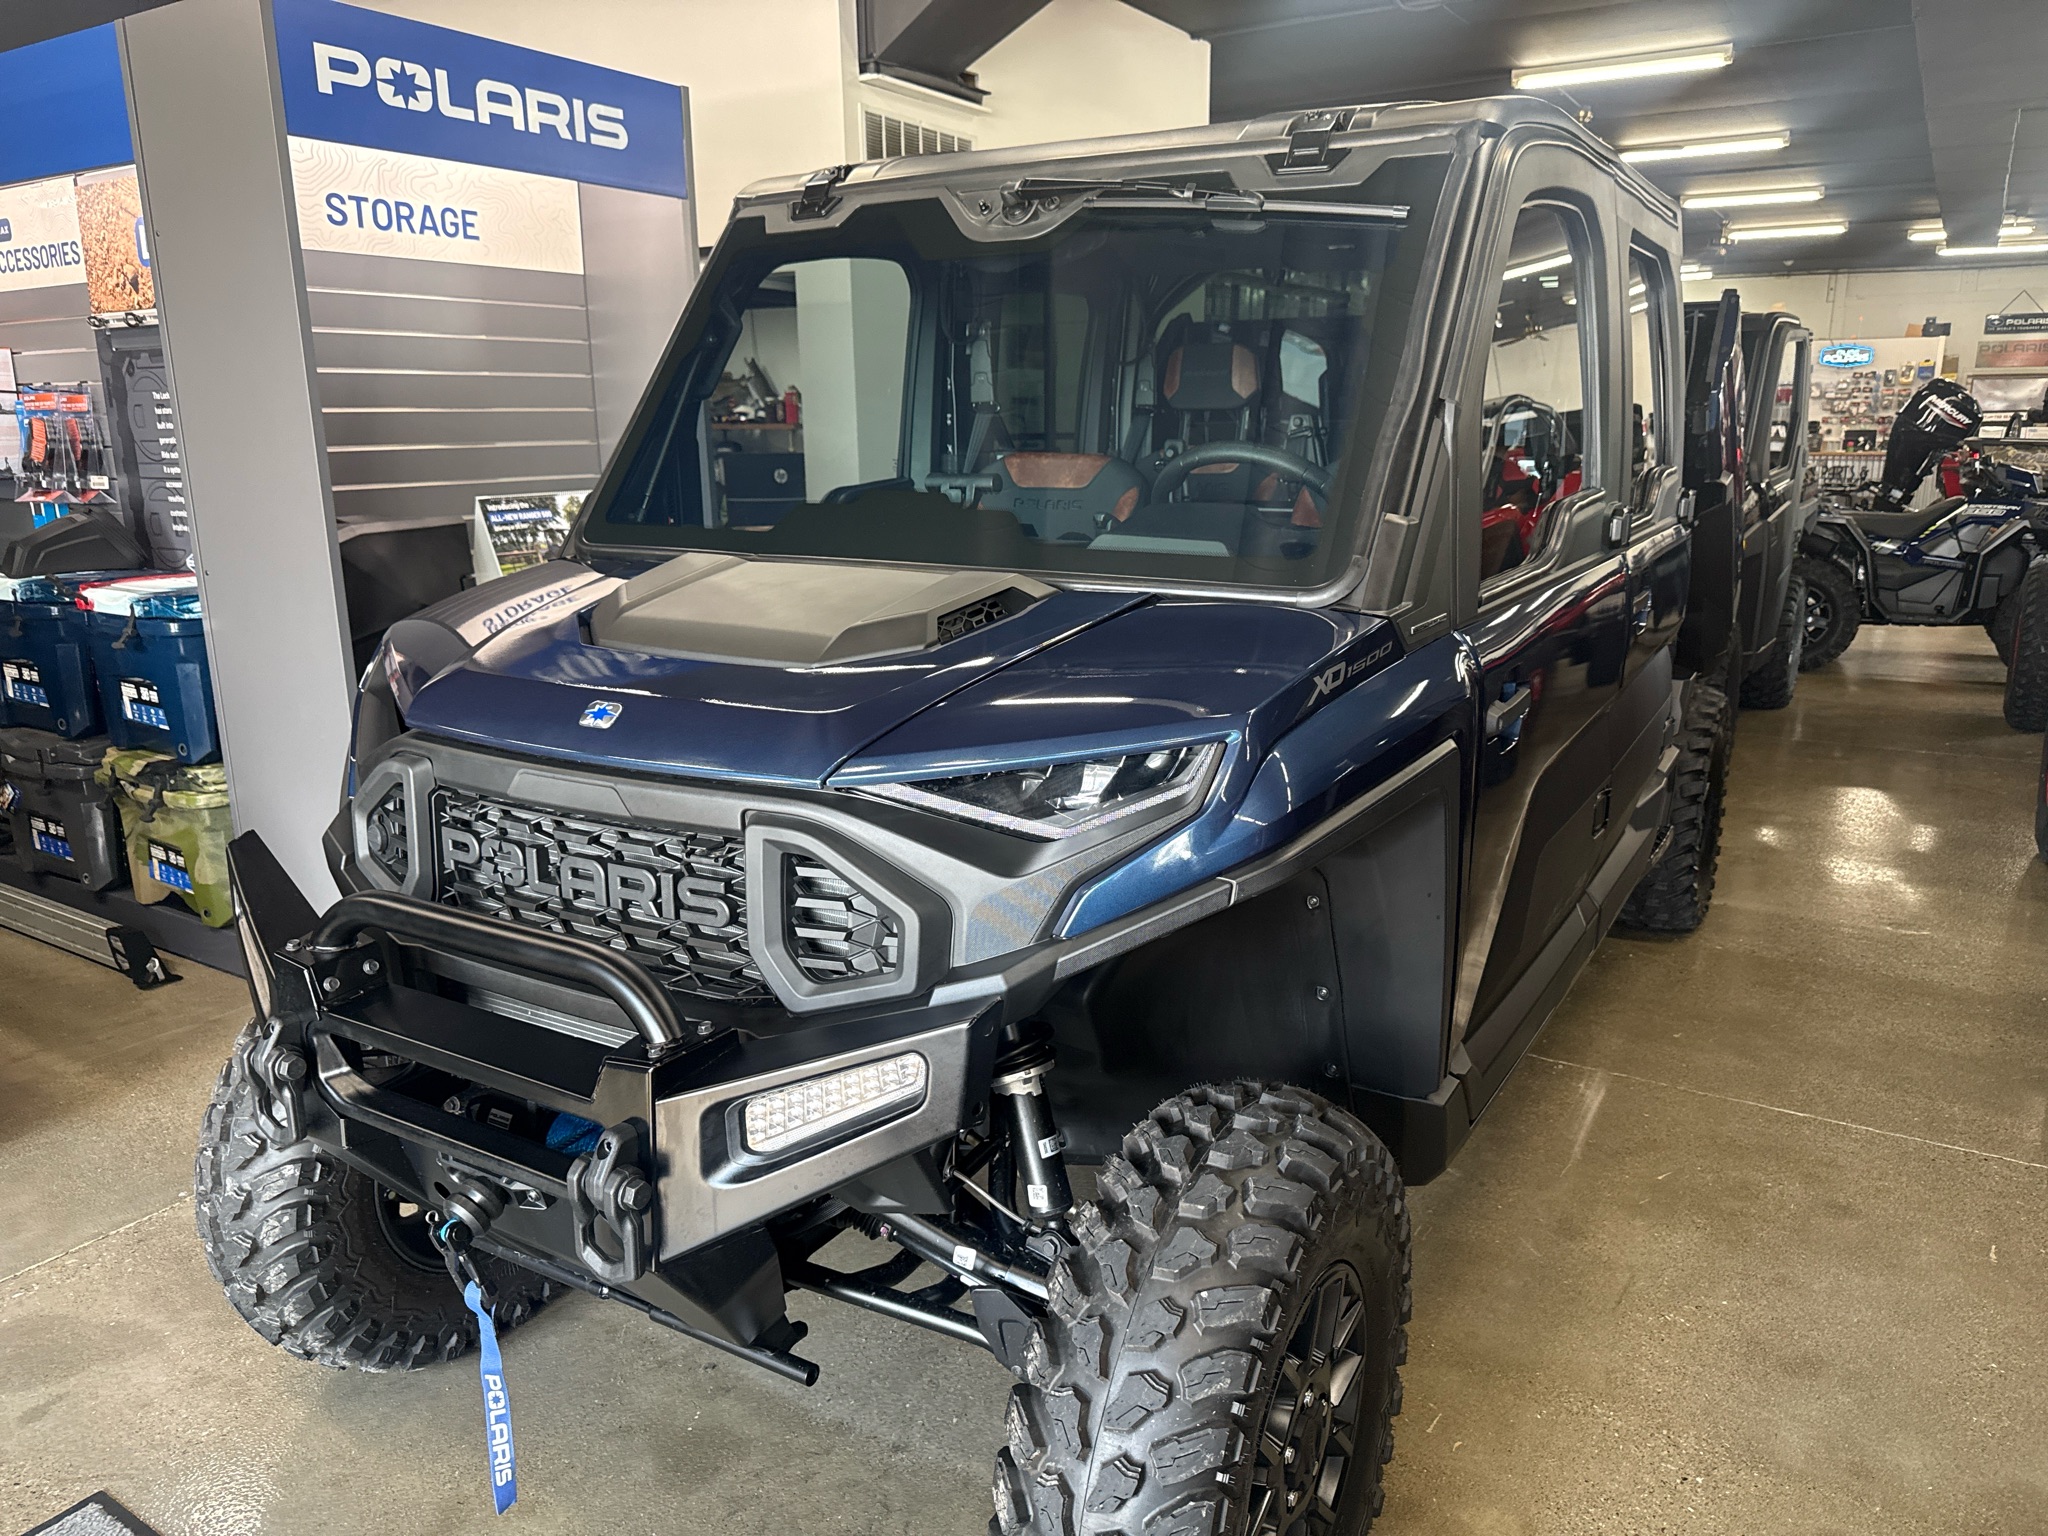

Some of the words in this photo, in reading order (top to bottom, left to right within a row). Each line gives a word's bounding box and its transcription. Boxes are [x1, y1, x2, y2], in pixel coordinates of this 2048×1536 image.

[312, 41, 628, 150] POLARIS
[325, 192, 480, 241] STORAGE
[1930, 397, 1973, 425] MERCURY
[490, 513, 518, 522] ALL-NEW
[1013, 497, 1082, 511] POLARIS
[1968, 503, 2021, 511] SPORTSMAN
[1307, 661, 1347, 707] XD
[1346, 641, 1393, 678] 1500
[442, 825, 738, 928] POLARIS
[484, 1373, 513, 1487] POLARIS
